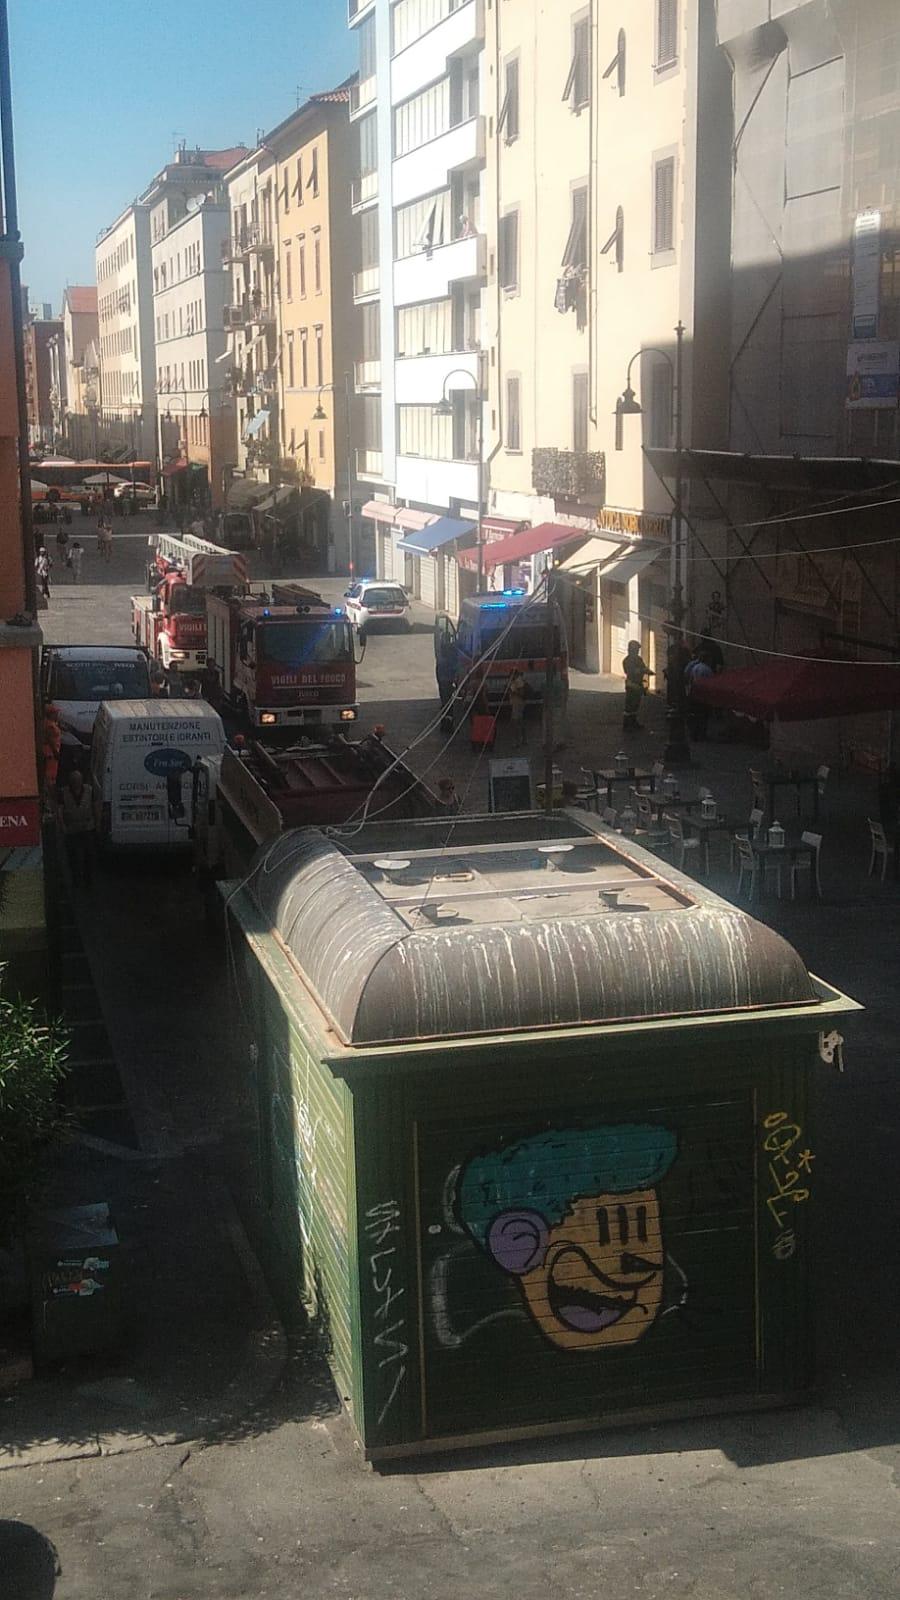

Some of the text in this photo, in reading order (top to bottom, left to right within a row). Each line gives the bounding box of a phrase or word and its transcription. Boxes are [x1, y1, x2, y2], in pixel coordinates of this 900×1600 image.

[270, 673, 346, 685] VIGILI DEL FUOCO
[129, 721, 201, 731] MANUTENZIONE
[123, 732, 168, 743] ESTINTORI
[176, 731, 211, 742] IDRANTI
